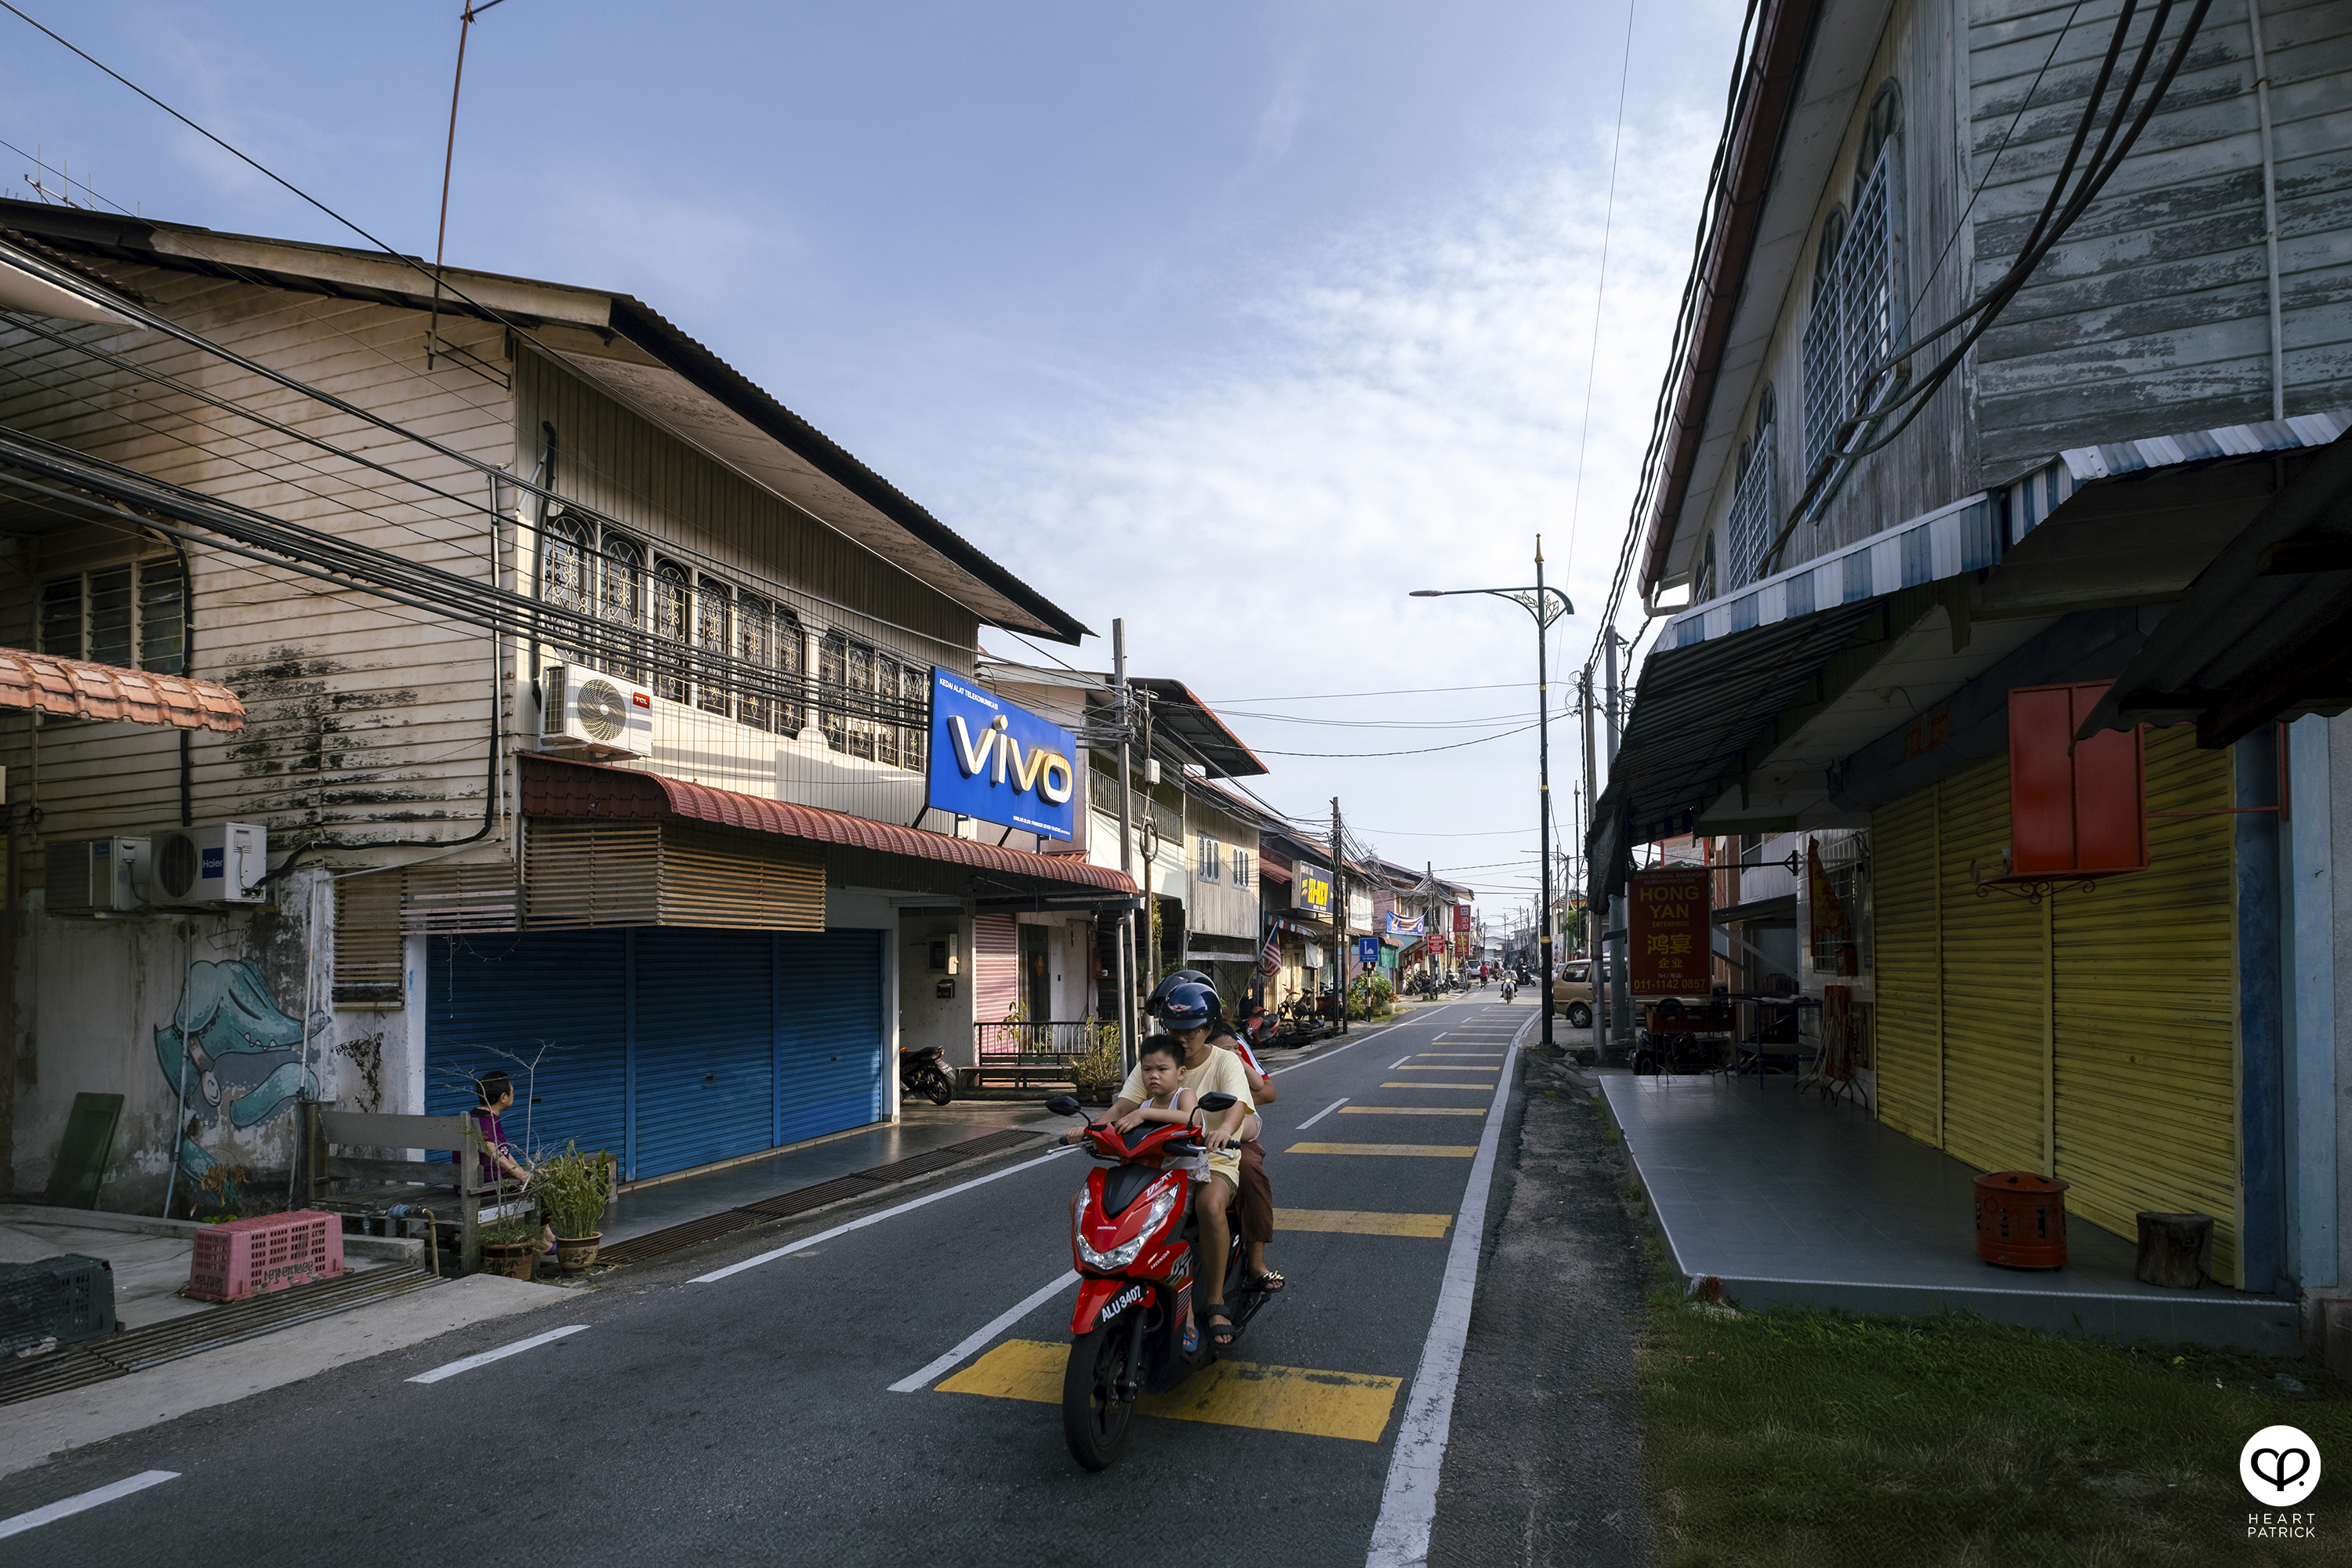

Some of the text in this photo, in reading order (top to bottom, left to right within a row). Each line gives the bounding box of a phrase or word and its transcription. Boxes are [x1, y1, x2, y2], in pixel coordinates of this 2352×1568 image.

[634, 695, 648, 706] TCL
[939, 677, 999, 710] KEDAI ALAT TELEKOMUNIKASI
[202, 858, 223, 869] Haier
[1639, 885, 1699, 902] HONG
[1649, 903, 1689, 919] YAN
[1646, 933, 1693, 955] 鸿宴
[1658, 957, 1683, 968] 企业
[1634, 978, 1706, 990] 011-1142 0857
[1150, 1250, 1171, 1270] HONDA
[1102, 1284, 1142, 1323] ALU 3407
